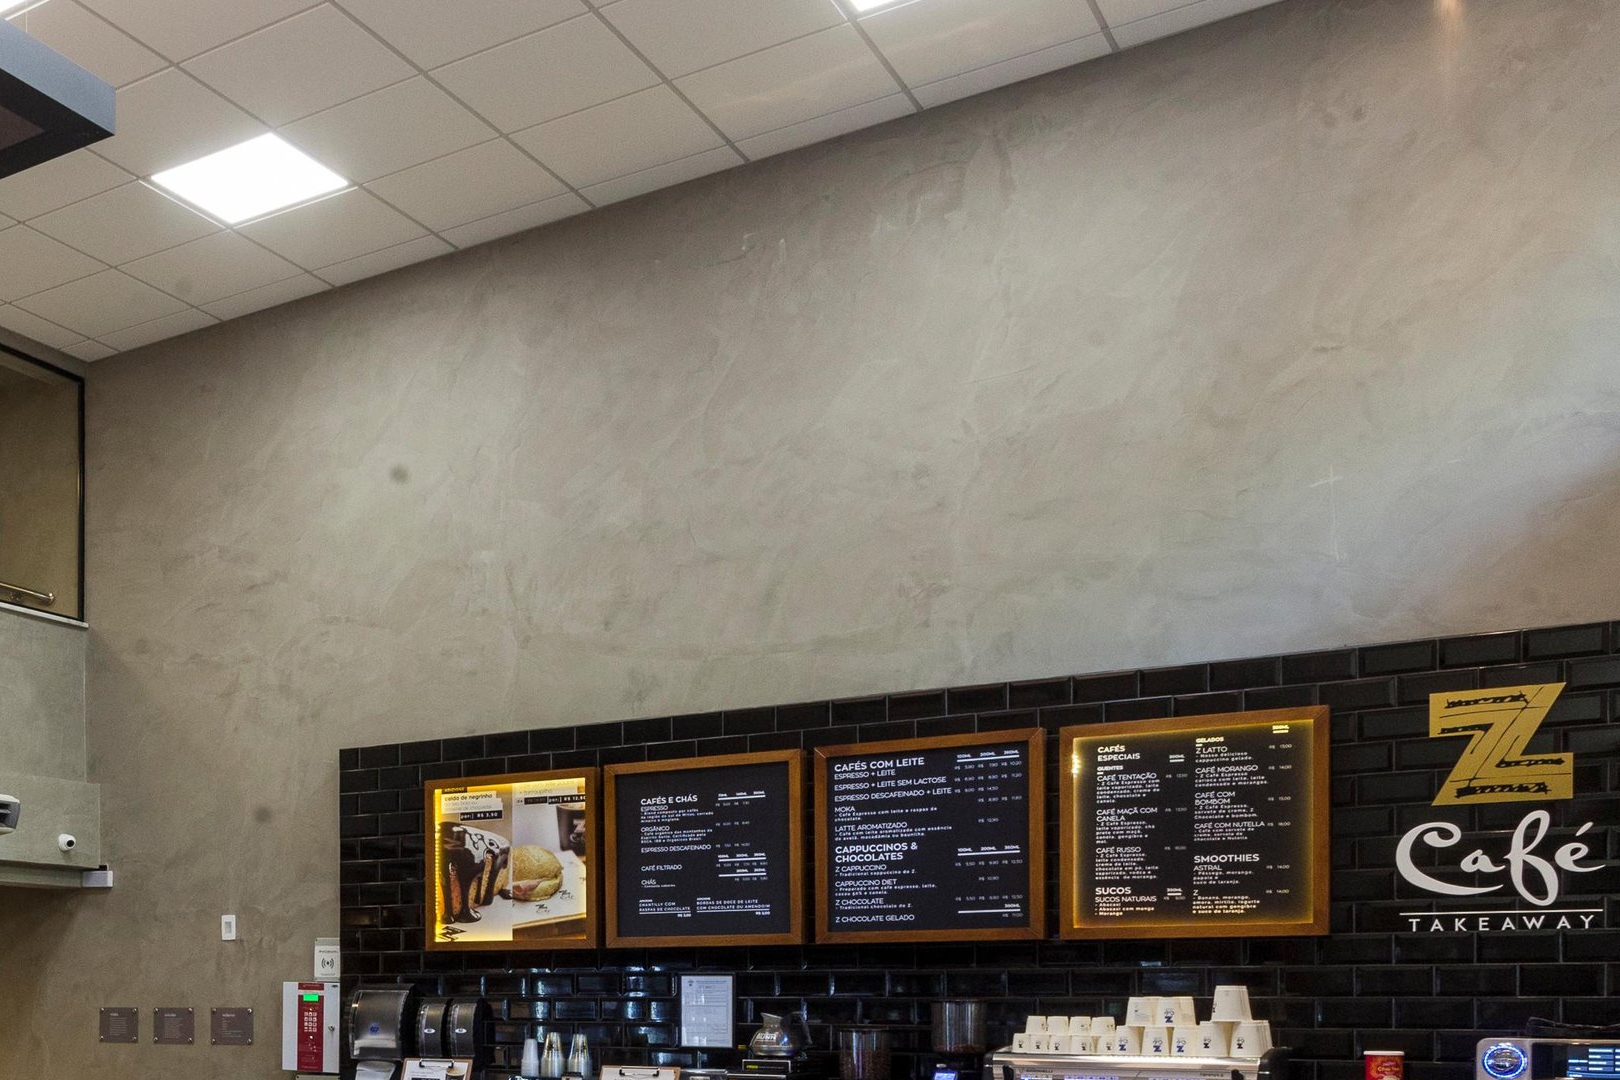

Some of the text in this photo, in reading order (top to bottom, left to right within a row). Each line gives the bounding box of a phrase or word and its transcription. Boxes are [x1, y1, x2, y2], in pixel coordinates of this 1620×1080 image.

[1098, 744, 1125, 753] CAFÉS
[1429, 682, 1574, 806] Z
[1098, 753, 1140, 761] ESPECIAIS
[835, 757, 924, 771] CAFÉS COM LEITE
[1195, 765, 1258, 774] CAFÉ MORANGO
[835, 772, 869, 780] ESPRESSO
[1118, 772, 1157, 780] TENTAÇÃO
[835, 783, 869, 791] ESPRESSO
[914, 776, 946, 785] LACTOSE
[641, 793, 698, 806] CAFÉS E CHÁS
[835, 794, 869, 802] ESPRESSO
[871, 790, 924, 800] DESCAFEINADO
[1195, 791, 1215, 799] CAFÉ
[1117, 807, 1138, 815] MAÇÃ
[640, 825, 670, 833] ORGÂNICO
[857, 822, 908, 831] AROMATIZADO
[669, 844, 711, 852] DESCAFEINADO
[835, 842, 918, 853] CAPPUCCINOS &
[835, 852, 903, 863] CHOCOLATES
[1194, 854, 1259, 863] SMOOTHIES
[1396, 810, 1606, 906] Café
[841, 864, 886, 872] CAPPUCCINO
[835, 879, 880, 887] CAPPUCCINO
[1095, 887, 1131, 895] SUCOS
[841, 915, 884, 923] CHOCOLATE
[1408, 915, 1595, 932] TAKEAWAY
